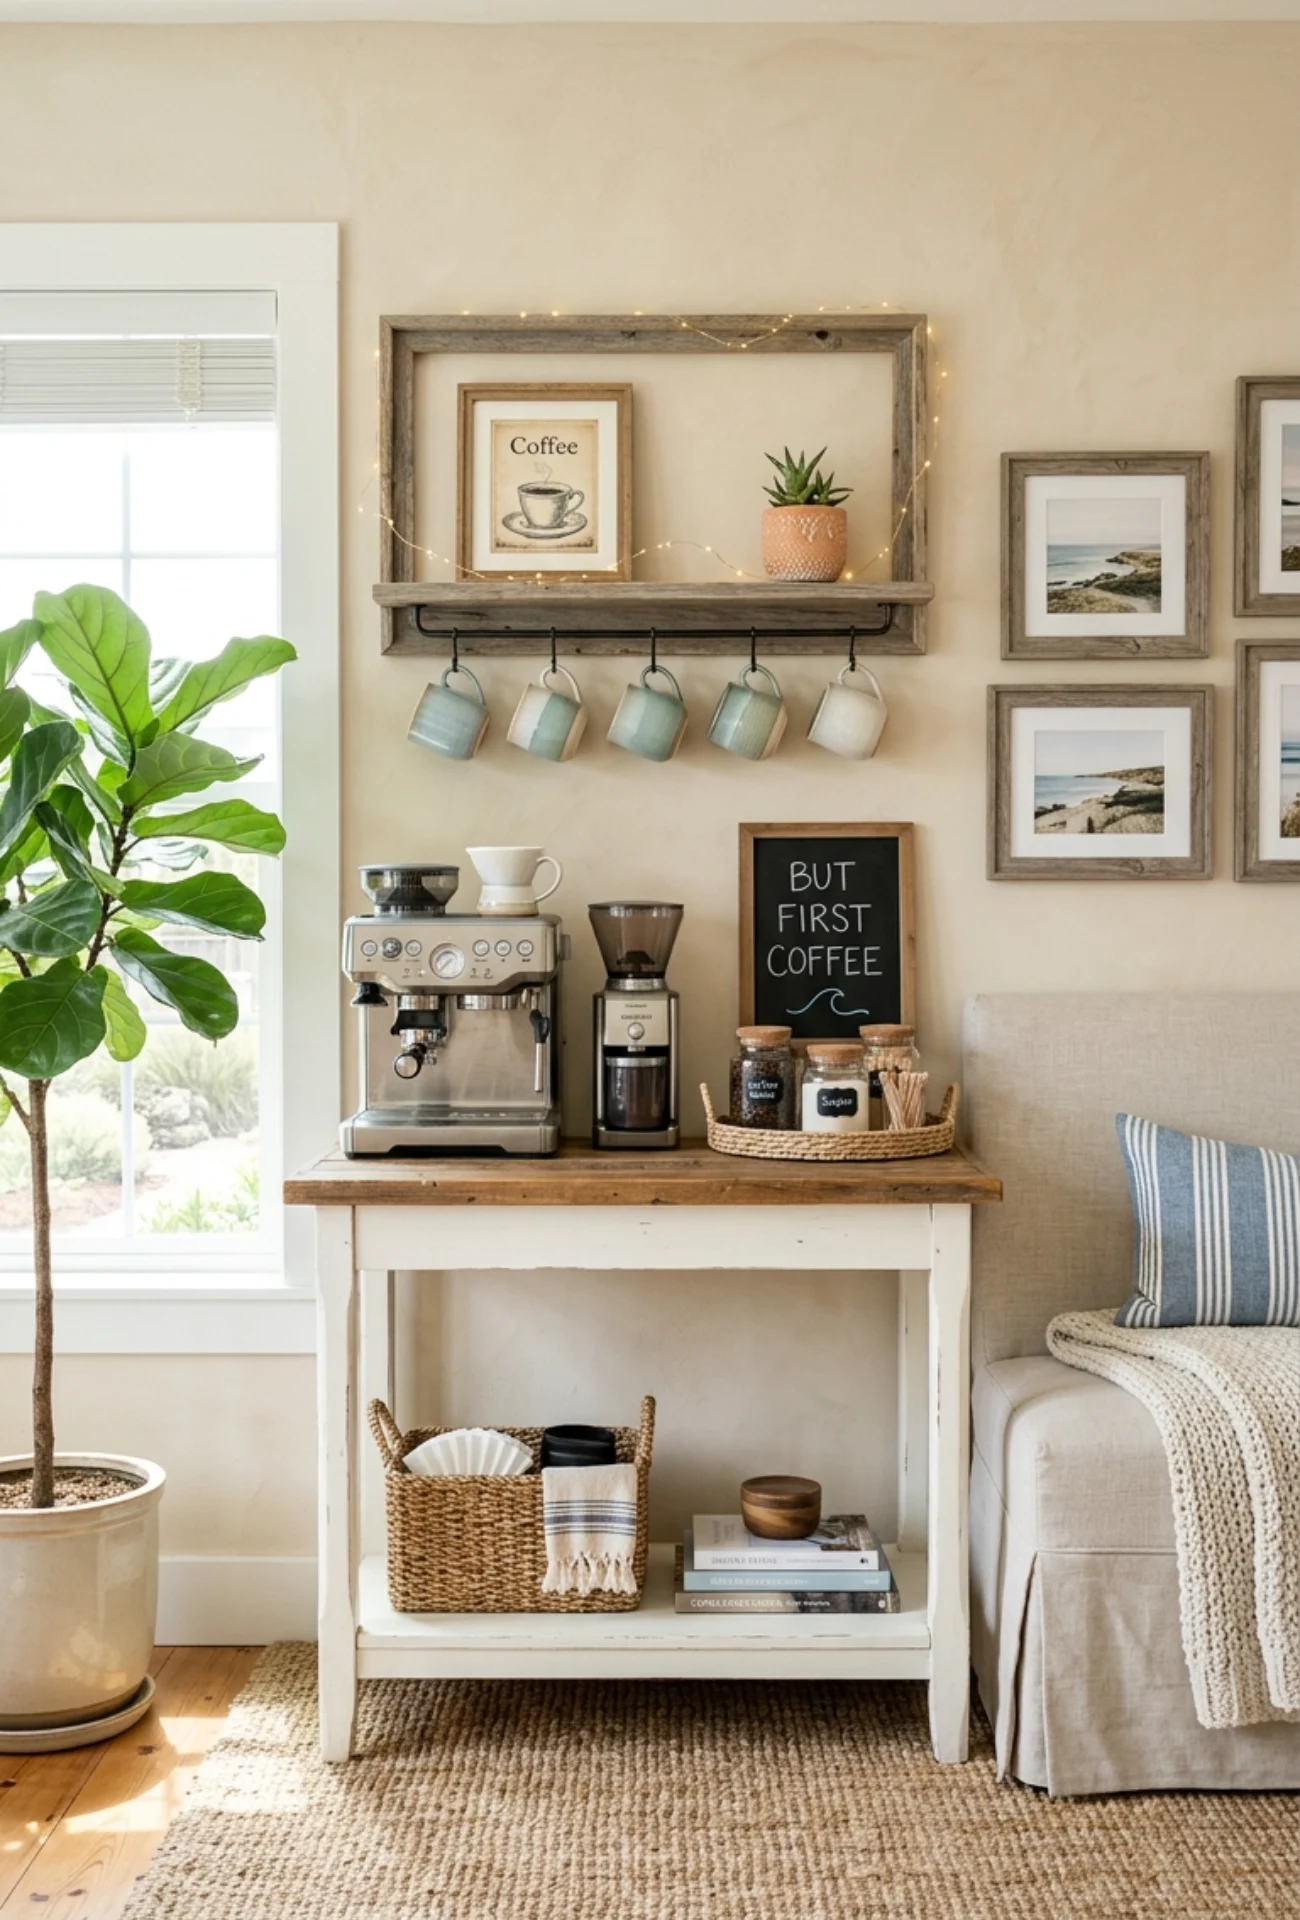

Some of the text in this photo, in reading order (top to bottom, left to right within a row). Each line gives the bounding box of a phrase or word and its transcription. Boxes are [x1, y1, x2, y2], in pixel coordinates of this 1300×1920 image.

[510, 436, 578, 455] Coffee
[790, 861, 856, 892] BUT
[778, 903, 872, 933] FIRST
[767, 944, 883, 977] COFFEE
